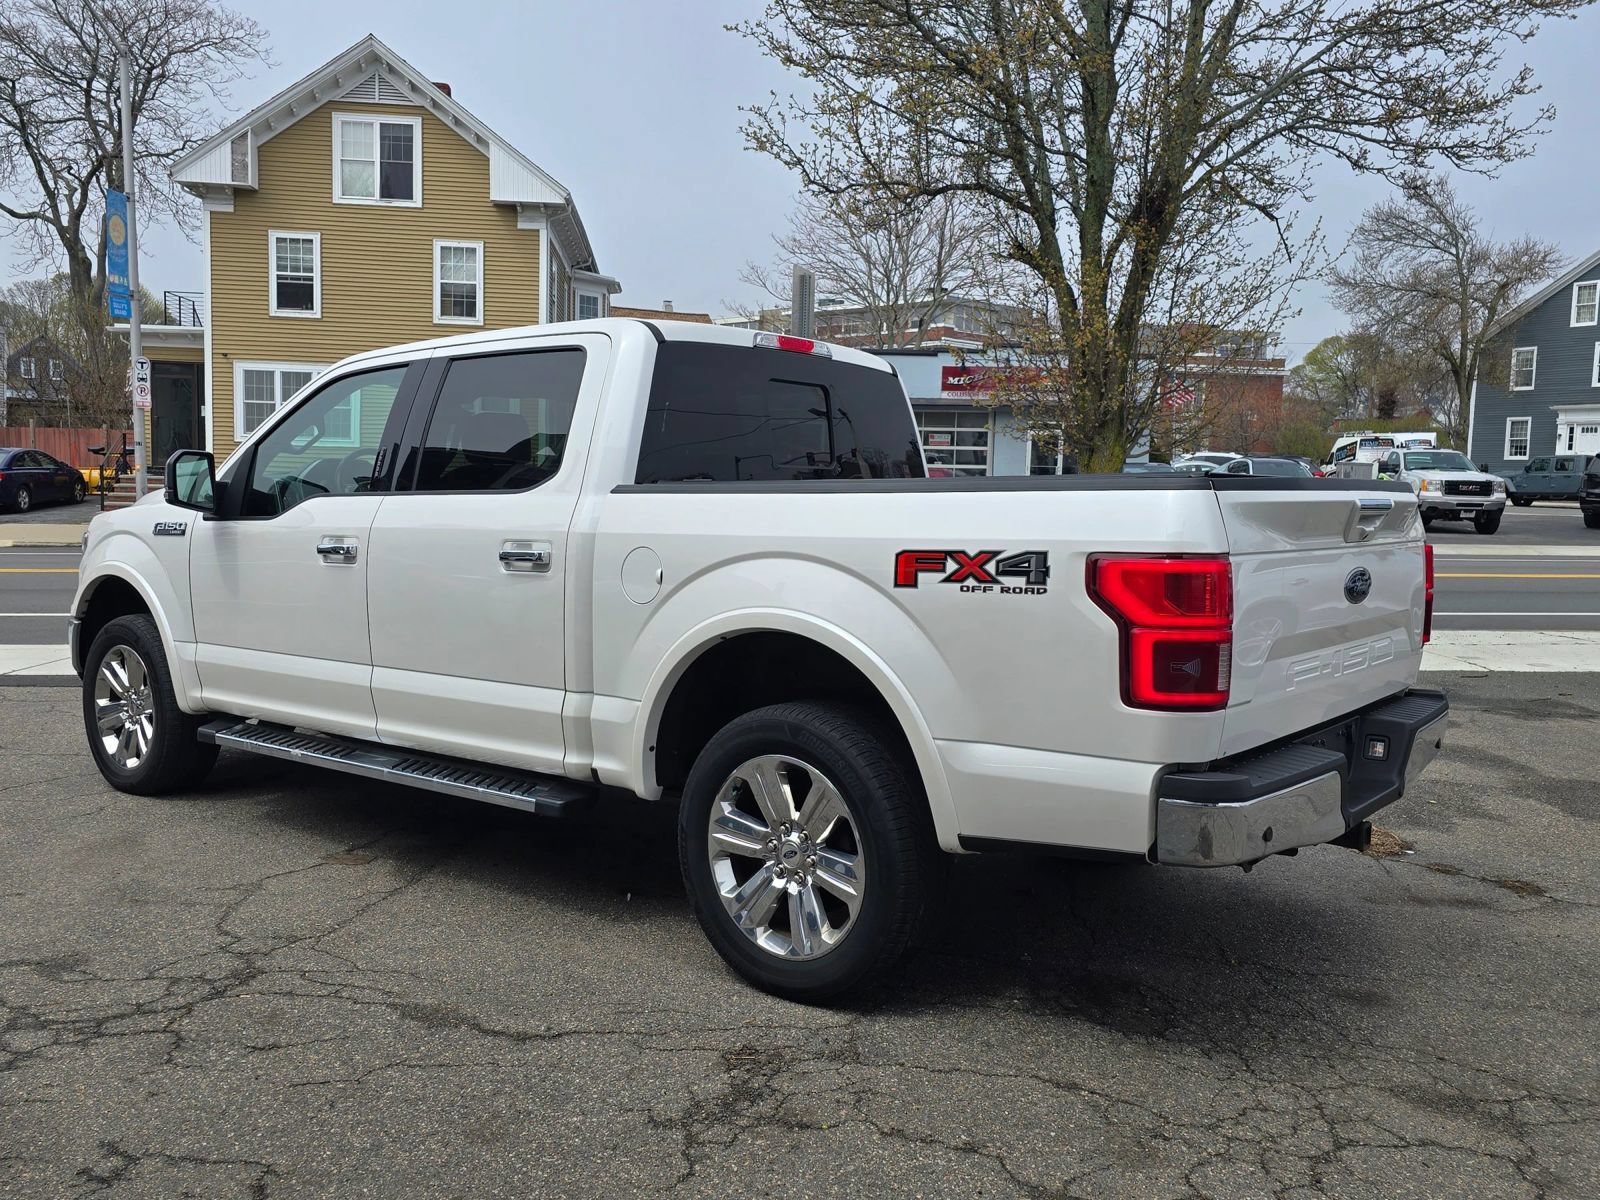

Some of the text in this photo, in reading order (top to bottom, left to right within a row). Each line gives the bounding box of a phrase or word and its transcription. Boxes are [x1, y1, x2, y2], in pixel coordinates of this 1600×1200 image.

[1459, 484, 1481, 492] GMC
[893, 549, 1050, 589] FX4
[959, 584, 1048, 596] OFF ROAD
